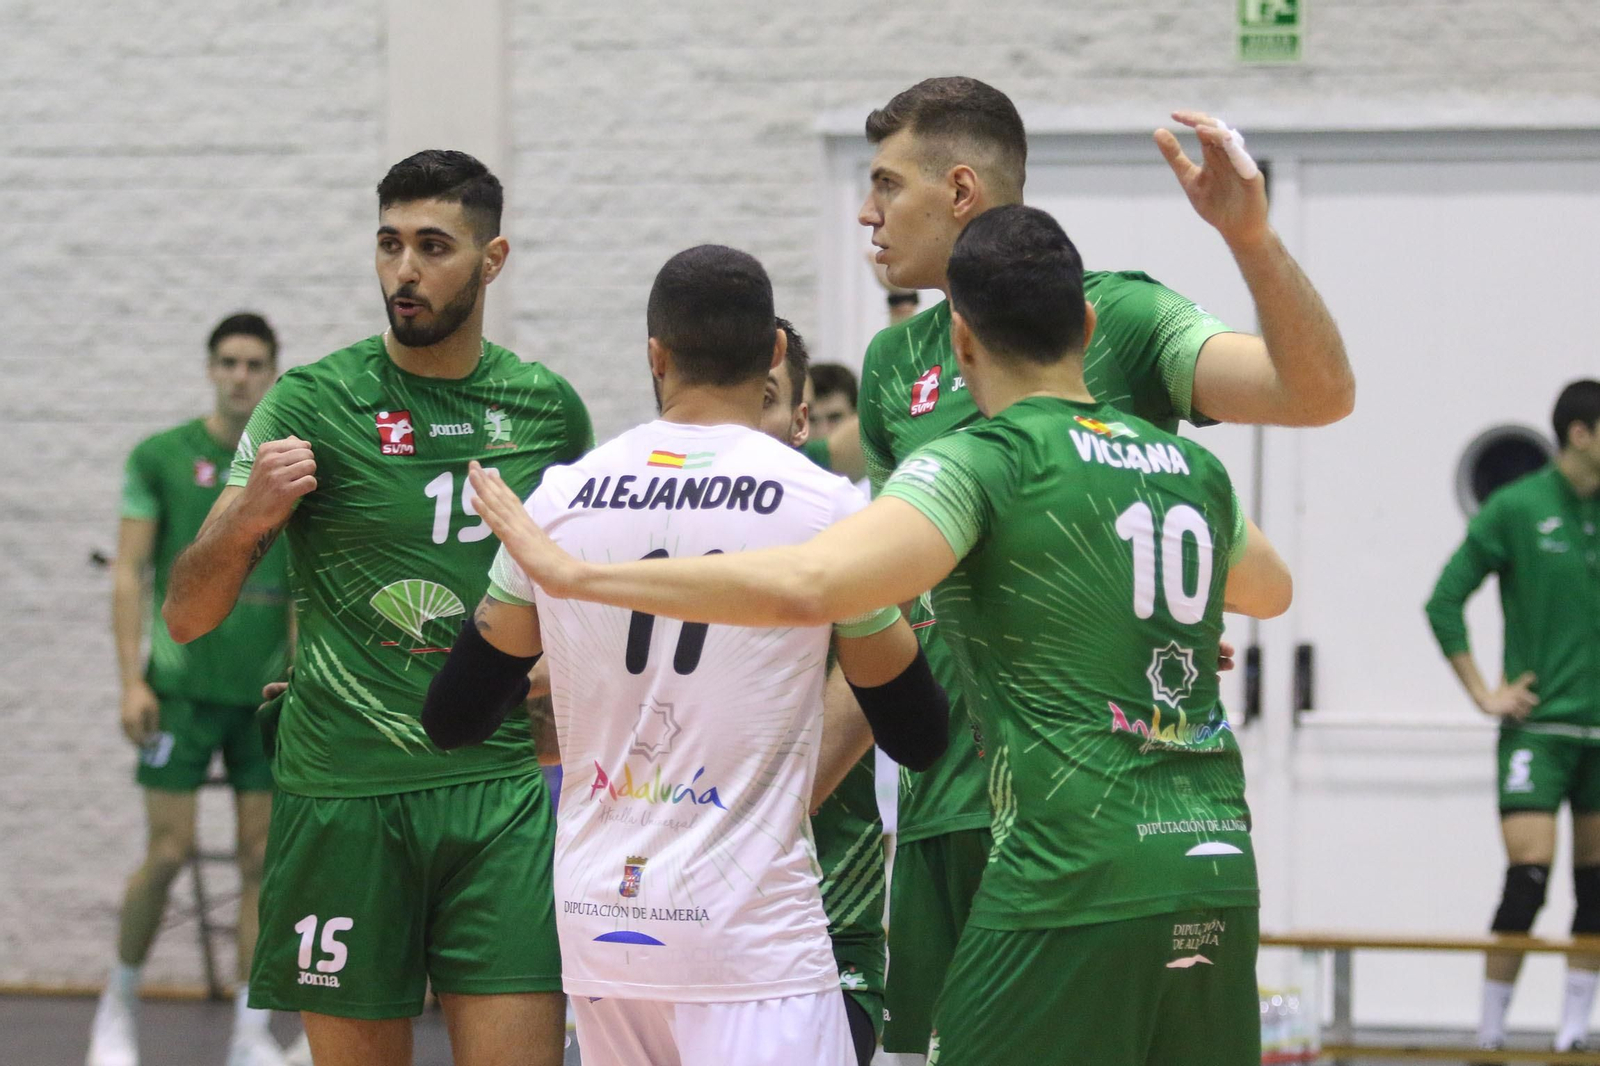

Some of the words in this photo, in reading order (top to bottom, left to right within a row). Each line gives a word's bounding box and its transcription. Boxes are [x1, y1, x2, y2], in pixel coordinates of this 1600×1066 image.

[429, 422, 474, 437] Joma
[382, 443, 415, 454] SVM
[1069, 429, 1190, 475] VICIANA
[568, 475, 785, 515] ALEJANDRO
[1115, 501, 1214, 625] 10
[564, 900, 629, 919] DIPUTACIÓN
[632, 906, 647, 920] DE
[650, 906, 710, 922] ALMERÍA
[294, 914, 354, 973] 15
[297, 971, 340, 988] Joma
